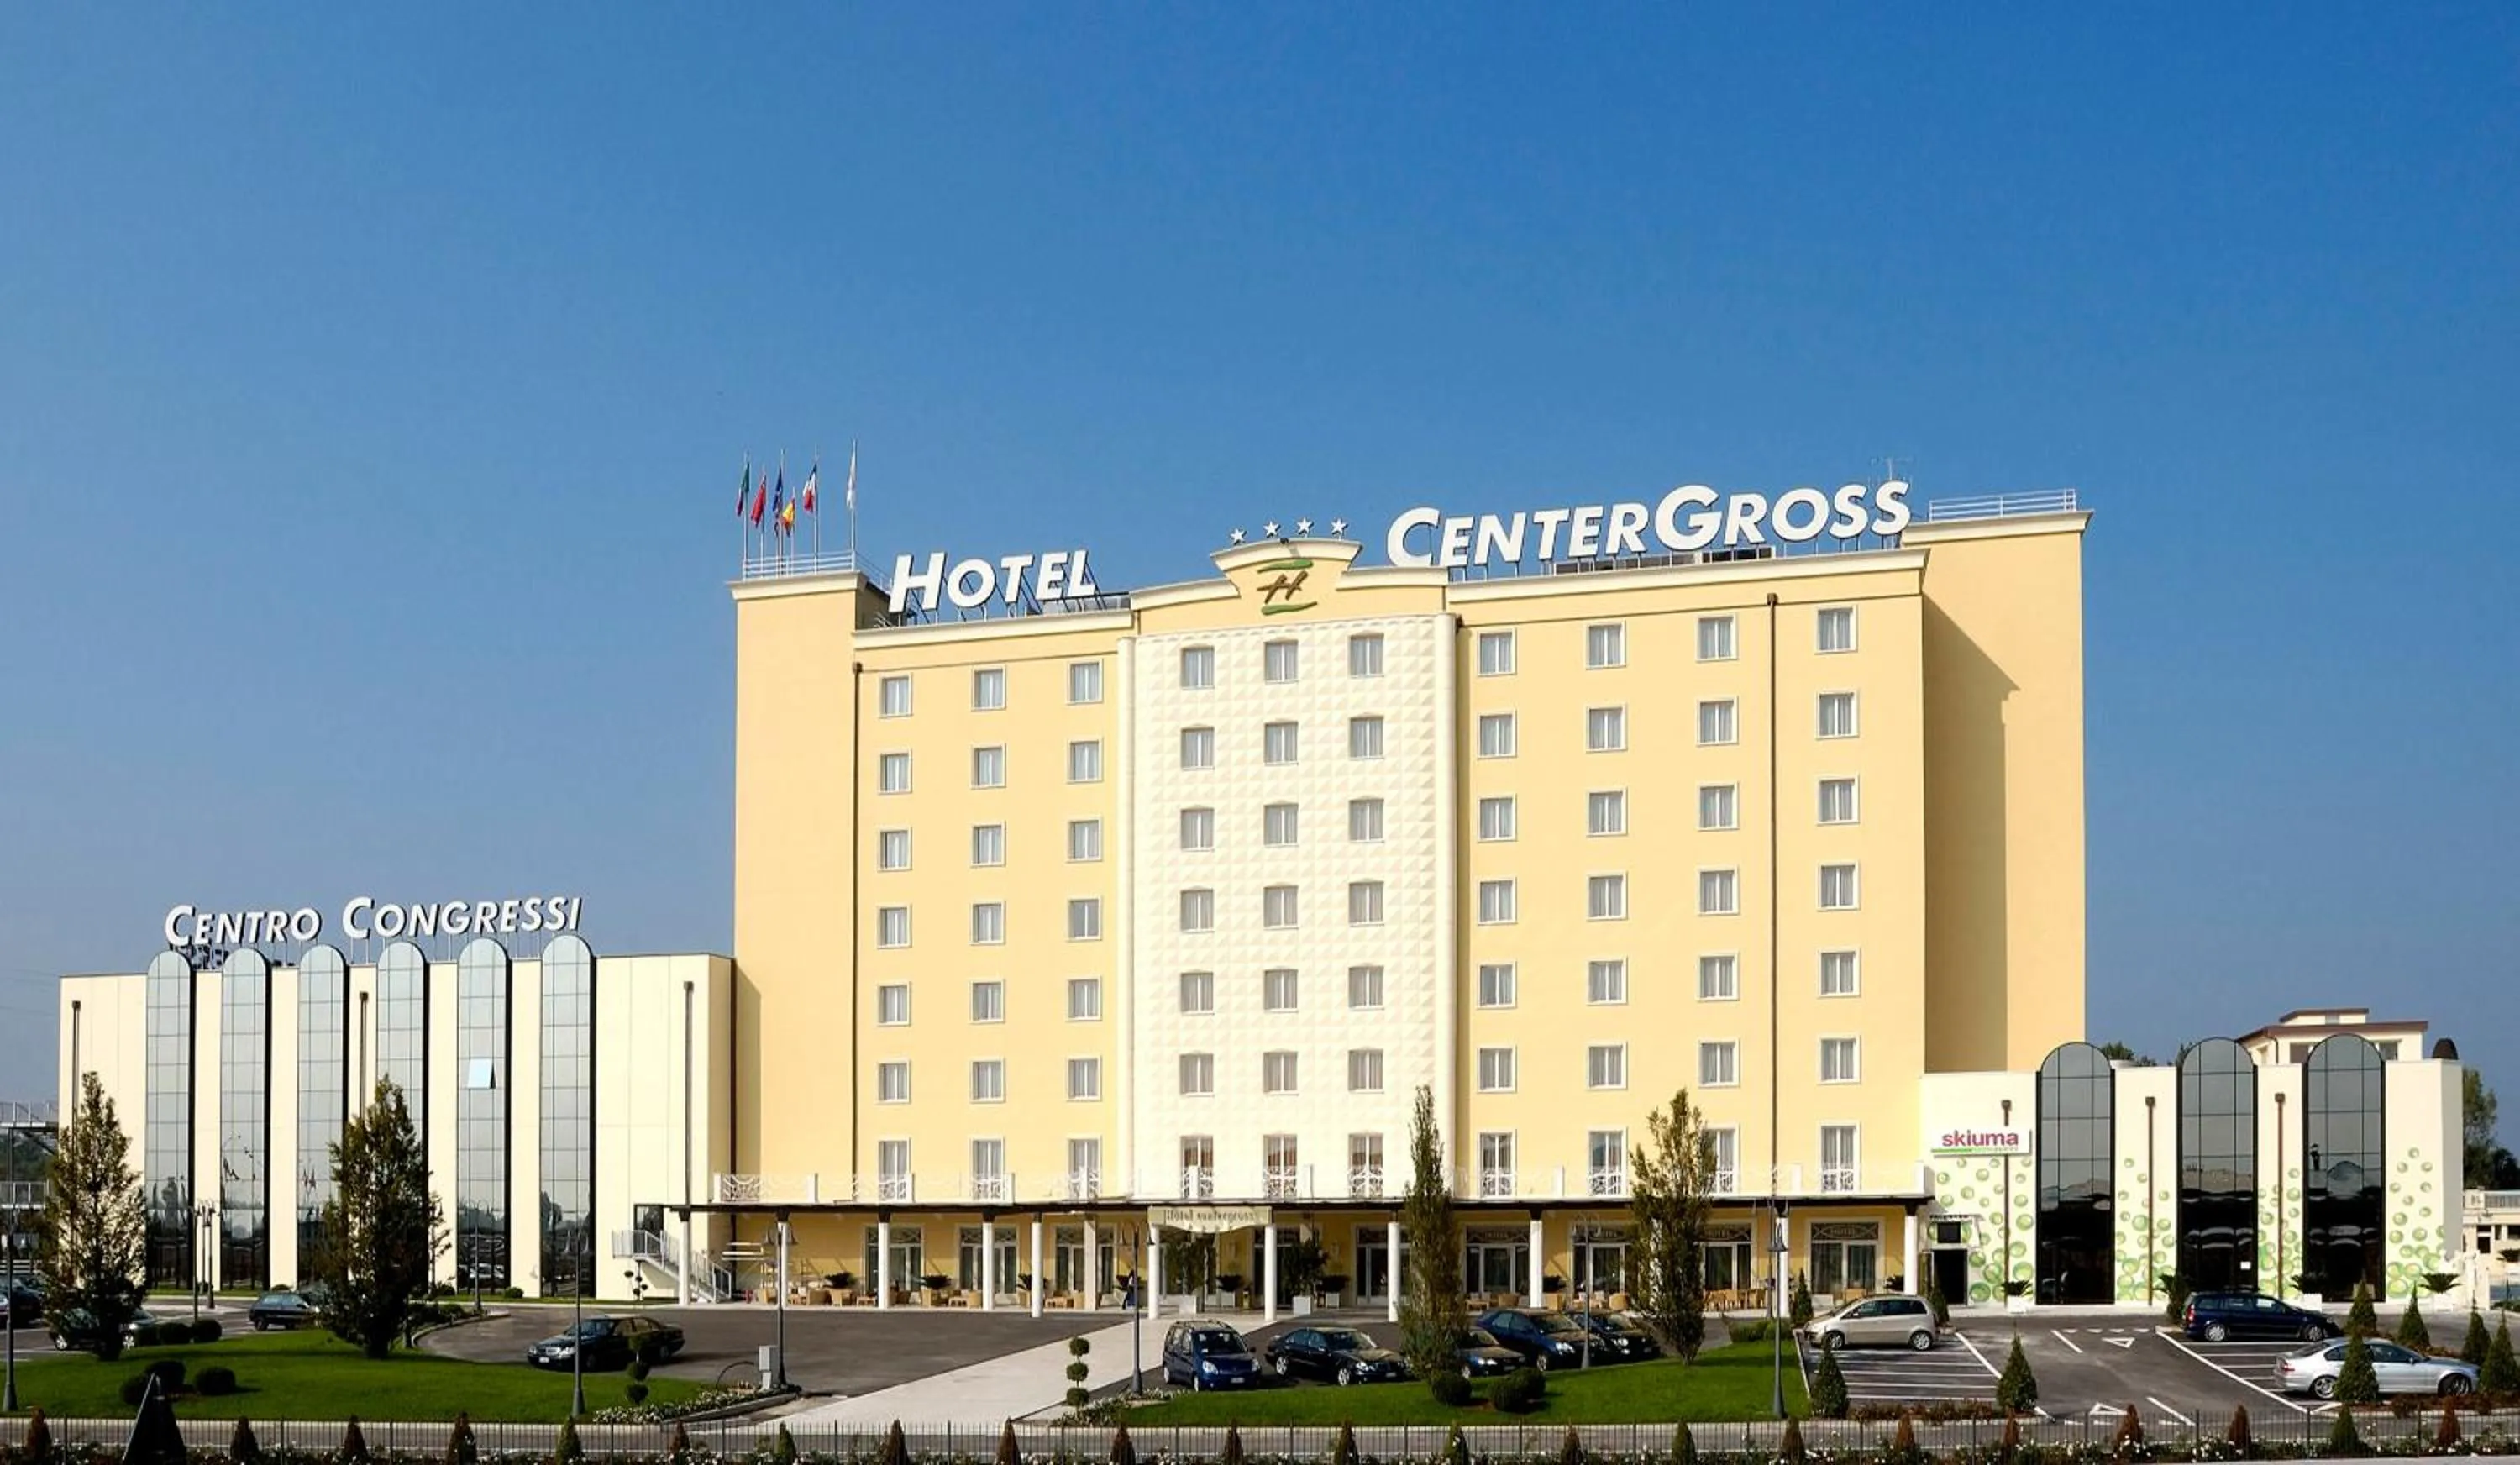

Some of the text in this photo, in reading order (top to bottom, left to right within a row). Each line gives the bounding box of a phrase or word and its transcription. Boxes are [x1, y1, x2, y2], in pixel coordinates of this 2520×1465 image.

[1386, 480, 1911, 568] CENTERGROSS
[889, 549, 1097, 613] HOTEL
[165, 896, 583, 946] CENTRO CONGRESSI
[1941, 1129, 2019, 1147] skiuma
